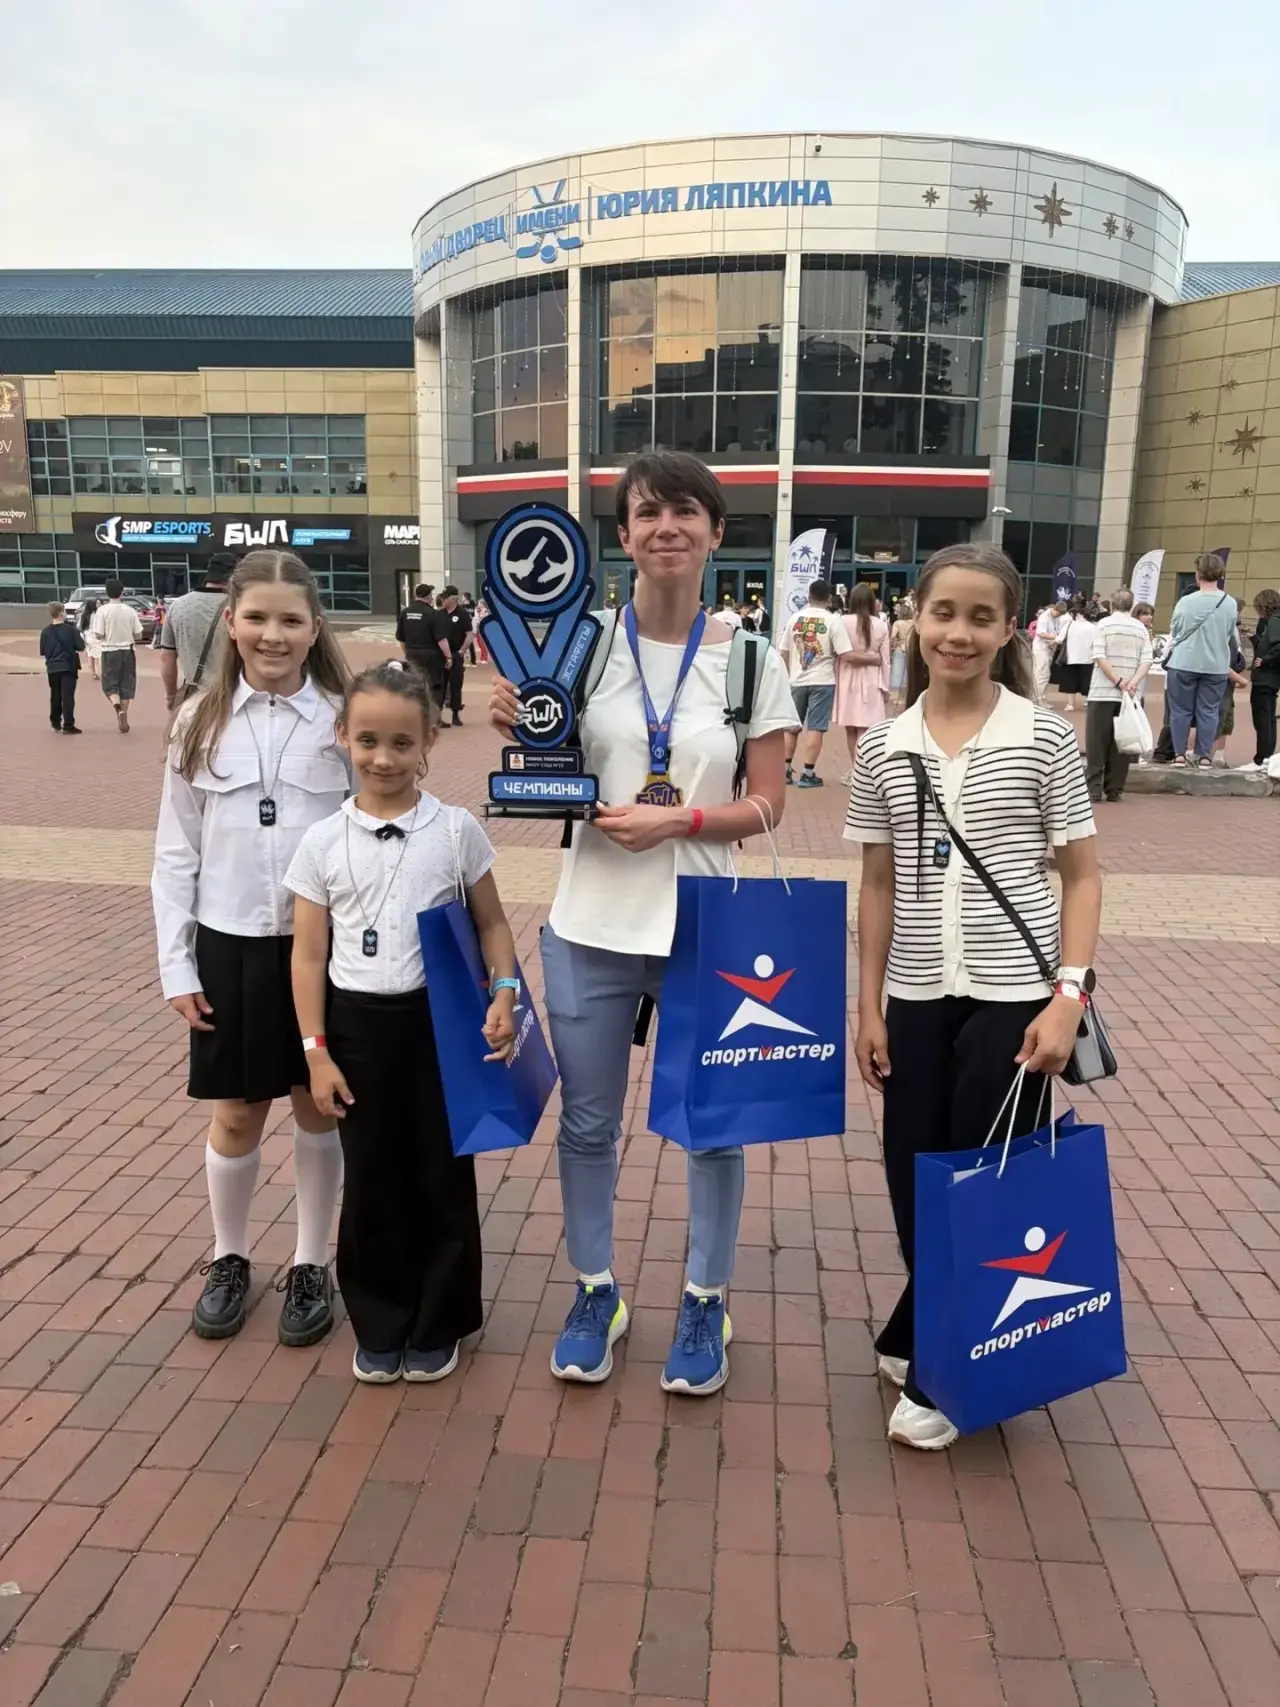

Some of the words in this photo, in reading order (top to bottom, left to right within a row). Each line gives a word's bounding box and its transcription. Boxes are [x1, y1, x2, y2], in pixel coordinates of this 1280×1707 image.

[445, 214, 508, 262] ДВОРЕЦ
[516, 203, 580, 234] ИМЕНИ
[597, 187, 679, 220] ЮРИЯ
[684, 180, 832, 211] ЛЯПКИНА
[122, 521, 152, 533] SMP
[153, 521, 211, 534] ESPORTS
[793, 623, 827, 634] MARIO
[562, 626, 591, 681] ЭСТАФЕТЫ
[503, 782, 583, 796] ЧЕМПИОНЫ
[701, 1043, 836, 1067] спортмастер
[970, 1290, 1111, 1360] спортмастер
